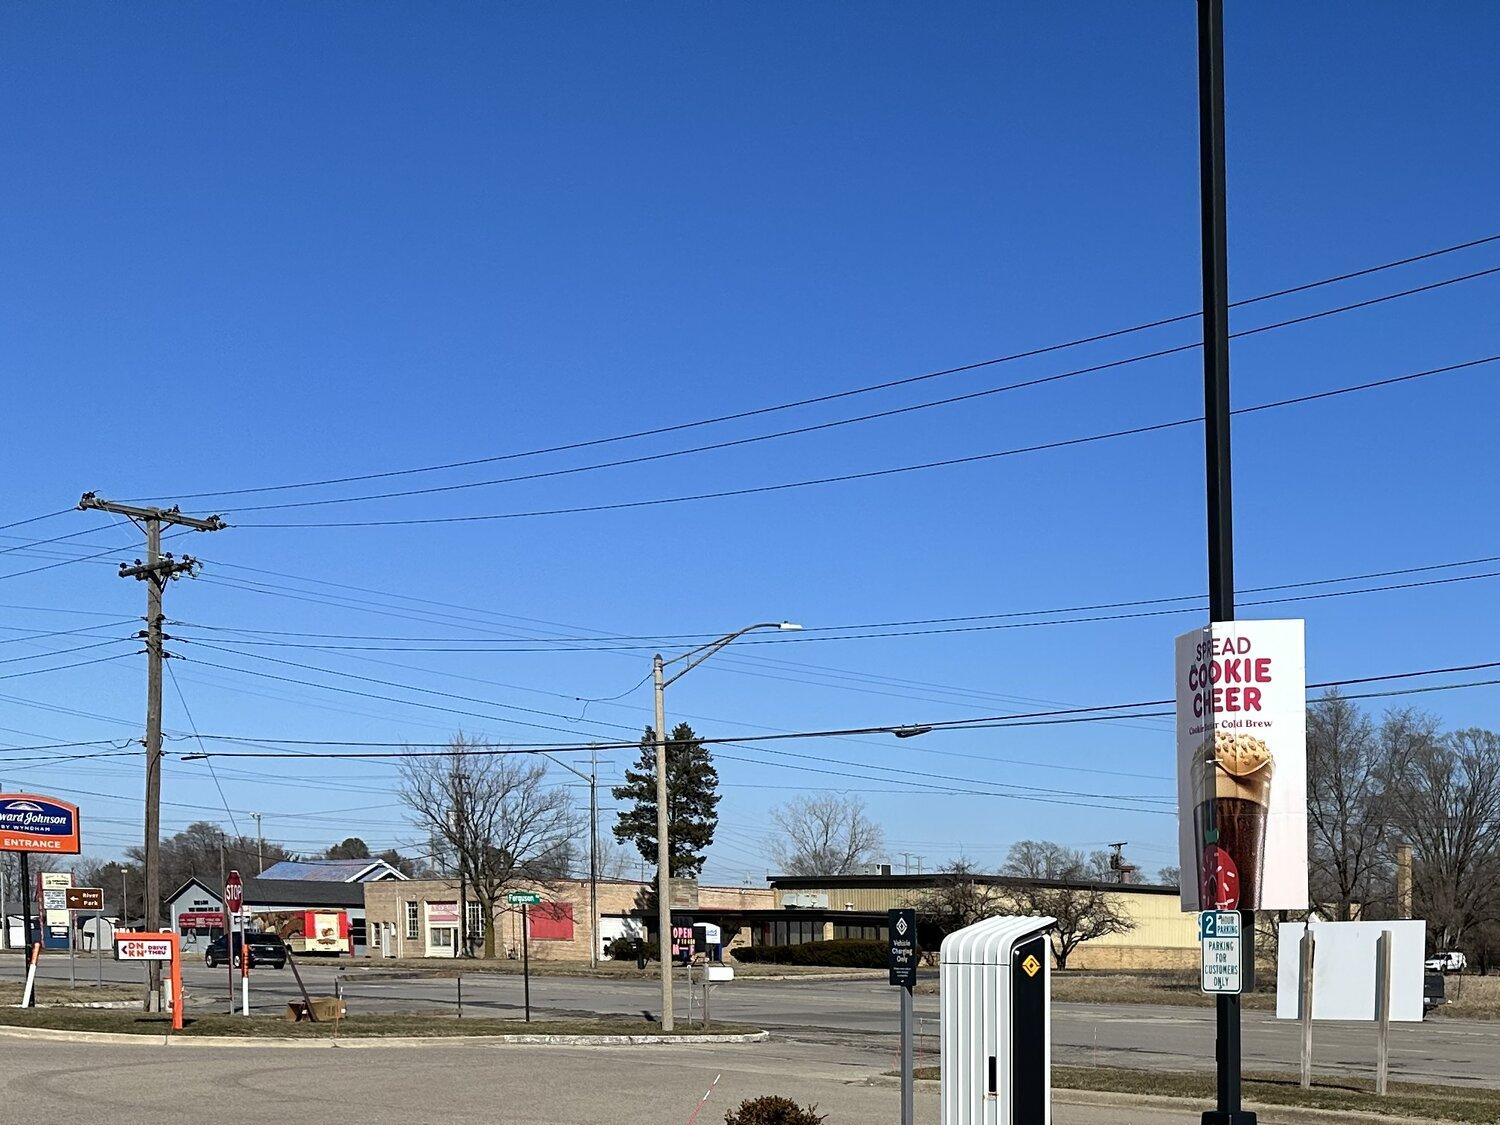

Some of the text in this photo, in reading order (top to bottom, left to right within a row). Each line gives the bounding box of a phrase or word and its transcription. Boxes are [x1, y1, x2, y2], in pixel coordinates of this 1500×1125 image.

[1196, 637, 1251, 661] SPREAD
[1189, 658, 1272, 691] COOKIE
[1194, 687, 1261, 718] CHEER
[1222, 720, 1242, 728] Cold
[24, 812, 67, 825] Johnson
[4, 838, 61, 849] ENTRANCE
[226, 884, 241, 900] STOP
[508, 894, 534, 903] Ferguson
[1205, 915, 1214, 934] 2
[1220, 916, 1234, 924] HOUR
[673, 927, 693, 938] OPEN
[1217, 925, 1238, 934] PARKING
[1208, 941, 1234, 951] PARKING
[1215, 953, 1227, 963] FOR
[1205, 964, 1238, 975] CUSTOMERS
[1213, 976, 1229, 987] ONLY
